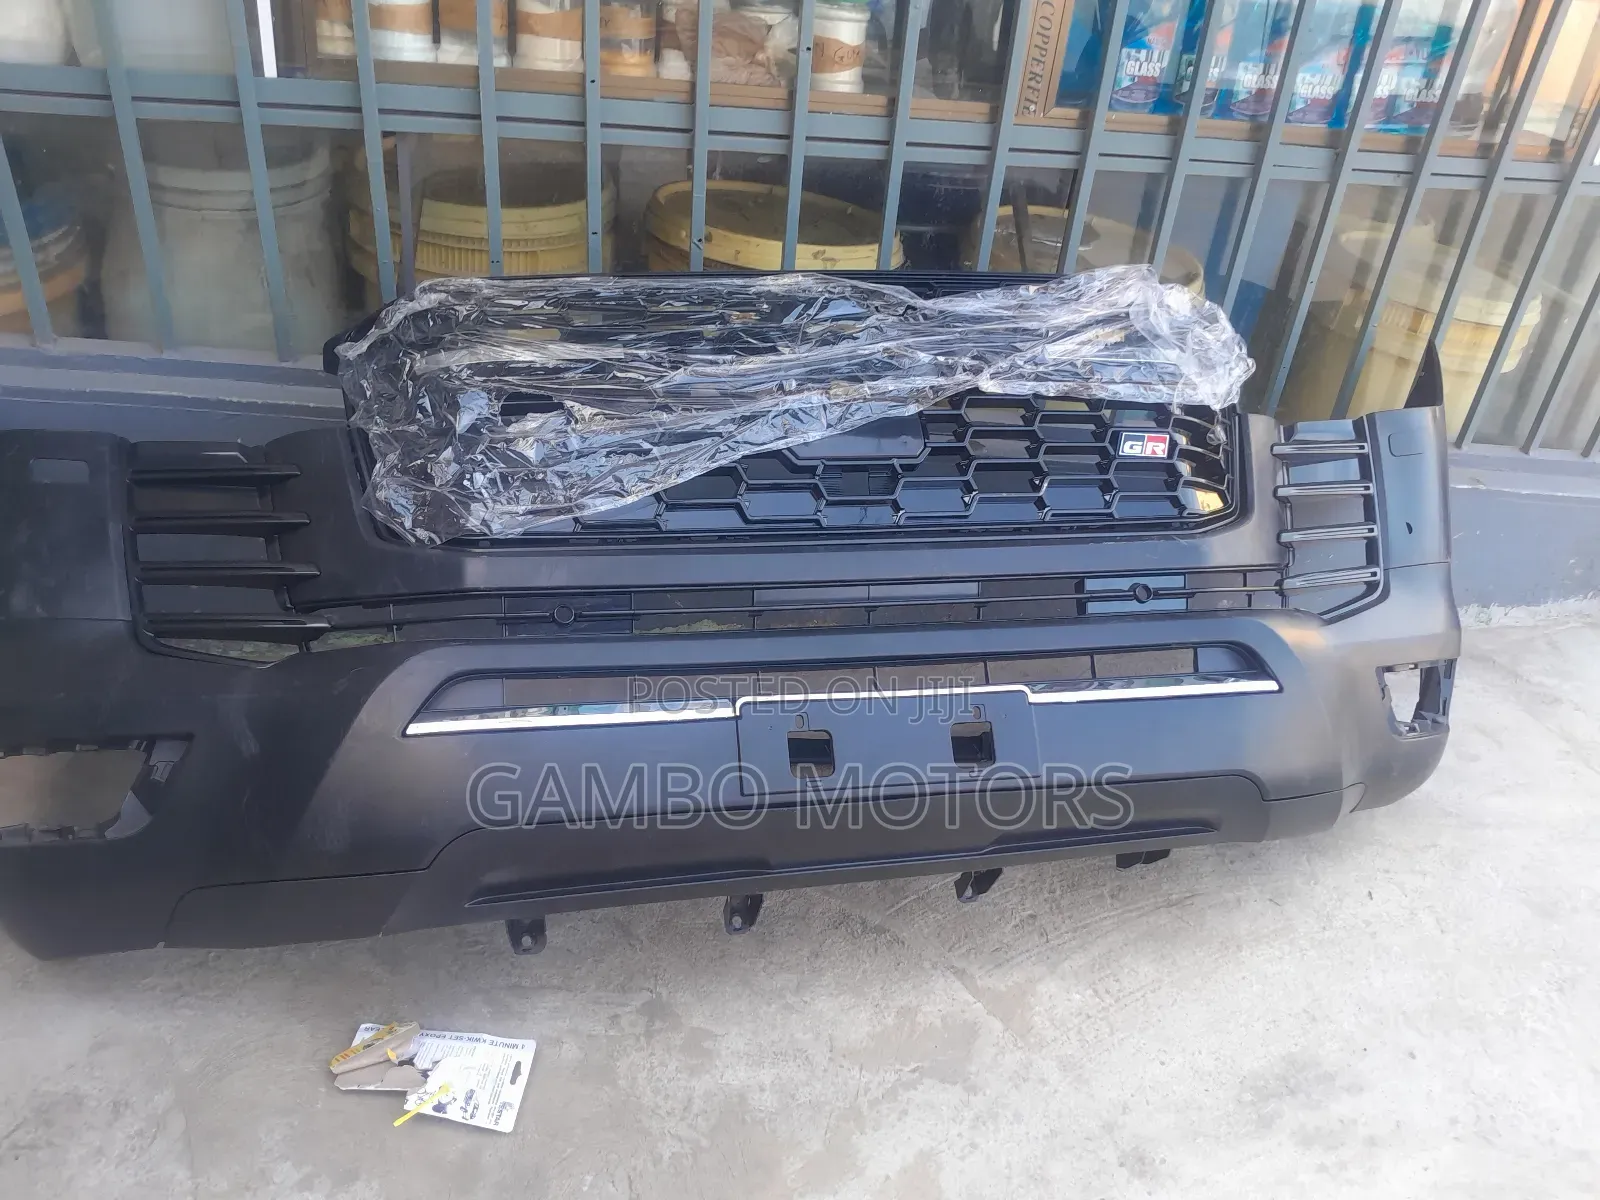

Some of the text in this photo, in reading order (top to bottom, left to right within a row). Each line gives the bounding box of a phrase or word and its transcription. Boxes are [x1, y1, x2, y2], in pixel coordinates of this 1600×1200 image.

[1126, 60, 1161, 77] GLASS
[1243, 73, 1279, 89] GLASS
[1300, 83, 1335, 100] GLASS
[1123, 440, 1166, 455] GR
[419, 1031, 447, 1040] EPOXY
[447, 1035, 488, 1045] KWIK-SET
[489, 1039, 520, 1050] MINUTE
